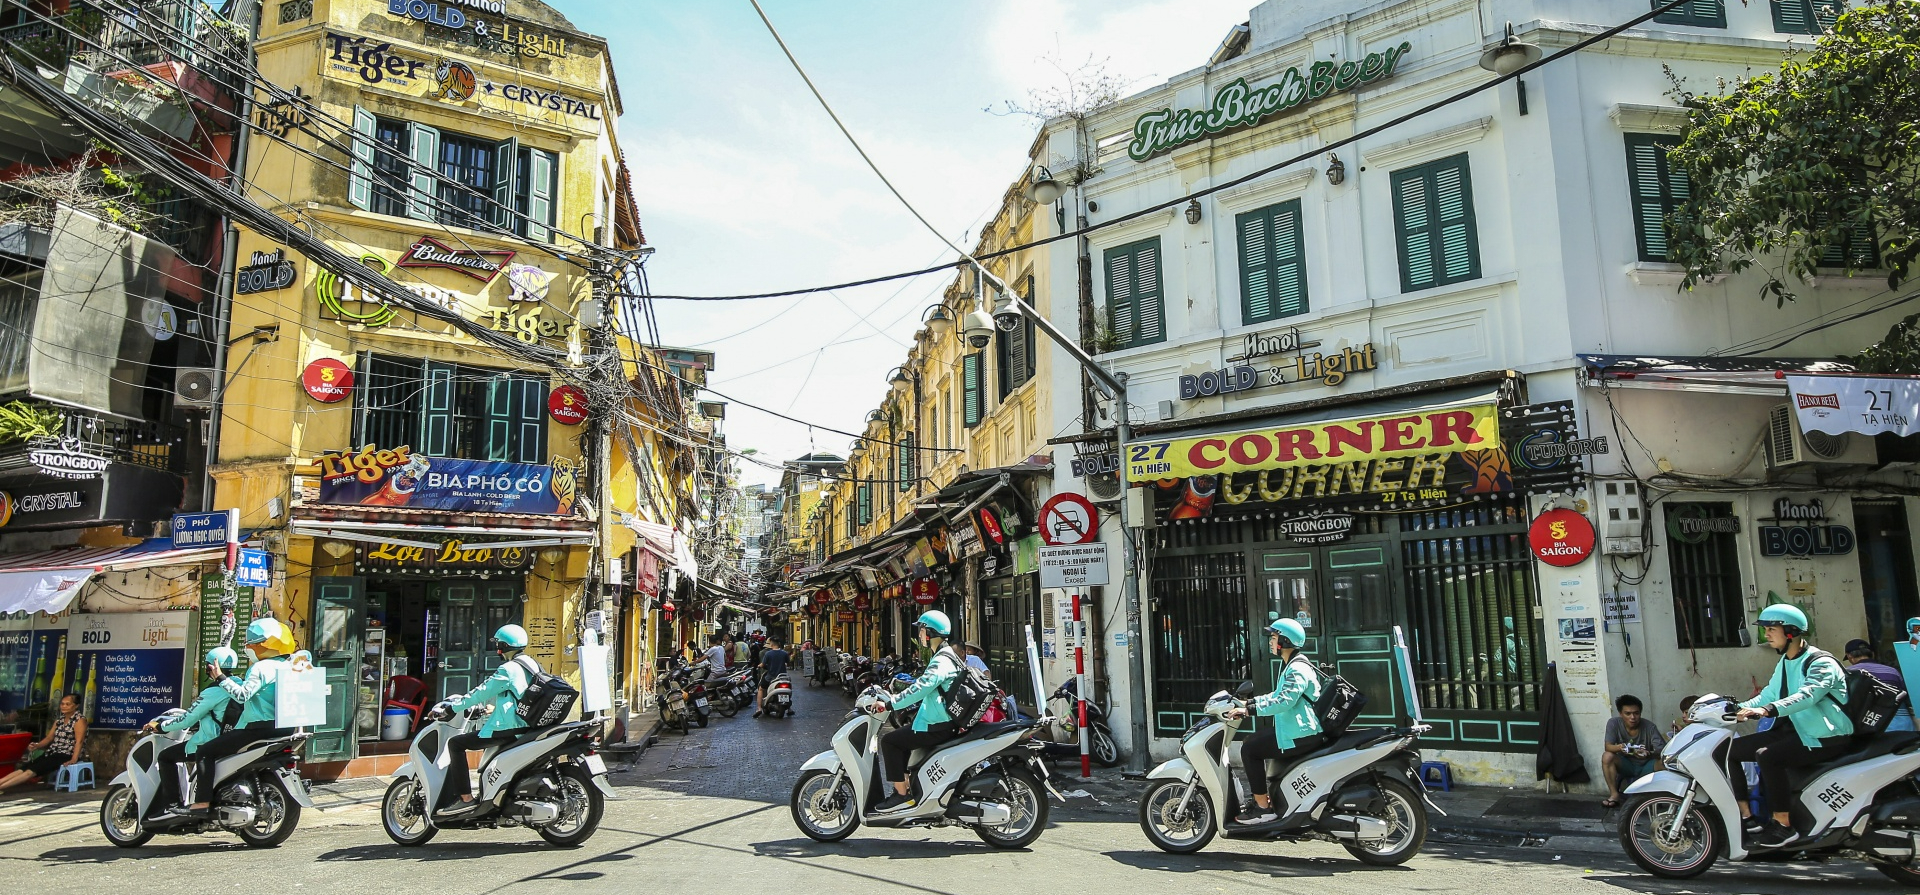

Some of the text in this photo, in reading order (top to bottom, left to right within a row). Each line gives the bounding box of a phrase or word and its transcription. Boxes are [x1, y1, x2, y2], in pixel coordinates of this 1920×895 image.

[388, 0, 568, 58] BOLD & Light
[326, 32, 425, 84] Tiger
[333, 64, 355, 73] SINCE
[1307, 41, 1412, 99] Beer
[502, 84, 601, 121] CRYSTAL
[1204, 70, 1306, 126] Bạch
[1130, 108, 1206, 161] Trúc
[250, 248, 280, 267] Hanoi
[410, 242, 501, 271] Budweiser
[236, 264, 296, 295] BOLD
[485, 303, 571, 345] Tiger
[1243, 326, 1300, 359] Hanoi
[1178, 342, 1379, 401] BOLD & Light
[310, 386, 345, 396] SAIGON
[1798, 394, 1838, 407] HANOI BEER
[1864, 390, 1892, 411] 27
[554, 408, 581, 418] SAIGON
[1862, 413, 1908, 428] TẠ HIỆN
[1080, 440, 1110, 454] Hanoi
[1187, 410, 1484, 470] CORNER
[1526, 436, 1609, 461] TUBORG
[30, 452, 108, 472] STRONGBOW
[1130, 443, 1171, 462] 27
[40, 468, 66, 478] APPLE
[312, 443, 411, 484] Tiger
[1132, 461, 1171, 477] TẠ HIỆN
[332, 474, 356, 486] SINCE
[428, 472, 463, 488] BIA
[467, 472, 512, 491] PHỐ
[515, 474, 543, 493] CỔ
[20, 491, 82, 512] CRYSTAL
[1382, 488, 1448, 503] 27 Tạ Hiện
[1778, 500, 1824, 520] Hanoi
[192, 516, 210, 527] PHỐ
[1280, 516, 1352, 534] STRONGBOW
[1678, 516, 1741, 534] TUBORG
[1318, 532, 1344, 542] CIDERS
[1762, 525, 1856, 557] BOLD
[248, 556, 262, 565] PHỐ
[1540, 546, 1584, 557] SAIGON
[239, 566, 268, 582] TẠ HIỆN
[1062, 568, 1080, 576] NGOẠI
[1064, 576, 1086, 584] Except
[207, 580, 220, 589] BIA
[82, 630, 111, 644] BOLD
[142, 628, 168, 647] Light
[150, 686, 160, 694] Rang
[952, 700, 964, 712] BAE
[488, 768, 502, 787] MIN
[926, 760, 942, 778] BAE
[929, 768, 947, 786] MIN
[1290, 772, 1310, 792] BAE
[1296, 780, 1317, 800] MIN
[1817, 782, 1846, 804] BAE
[1828, 792, 1855, 813] MIN
